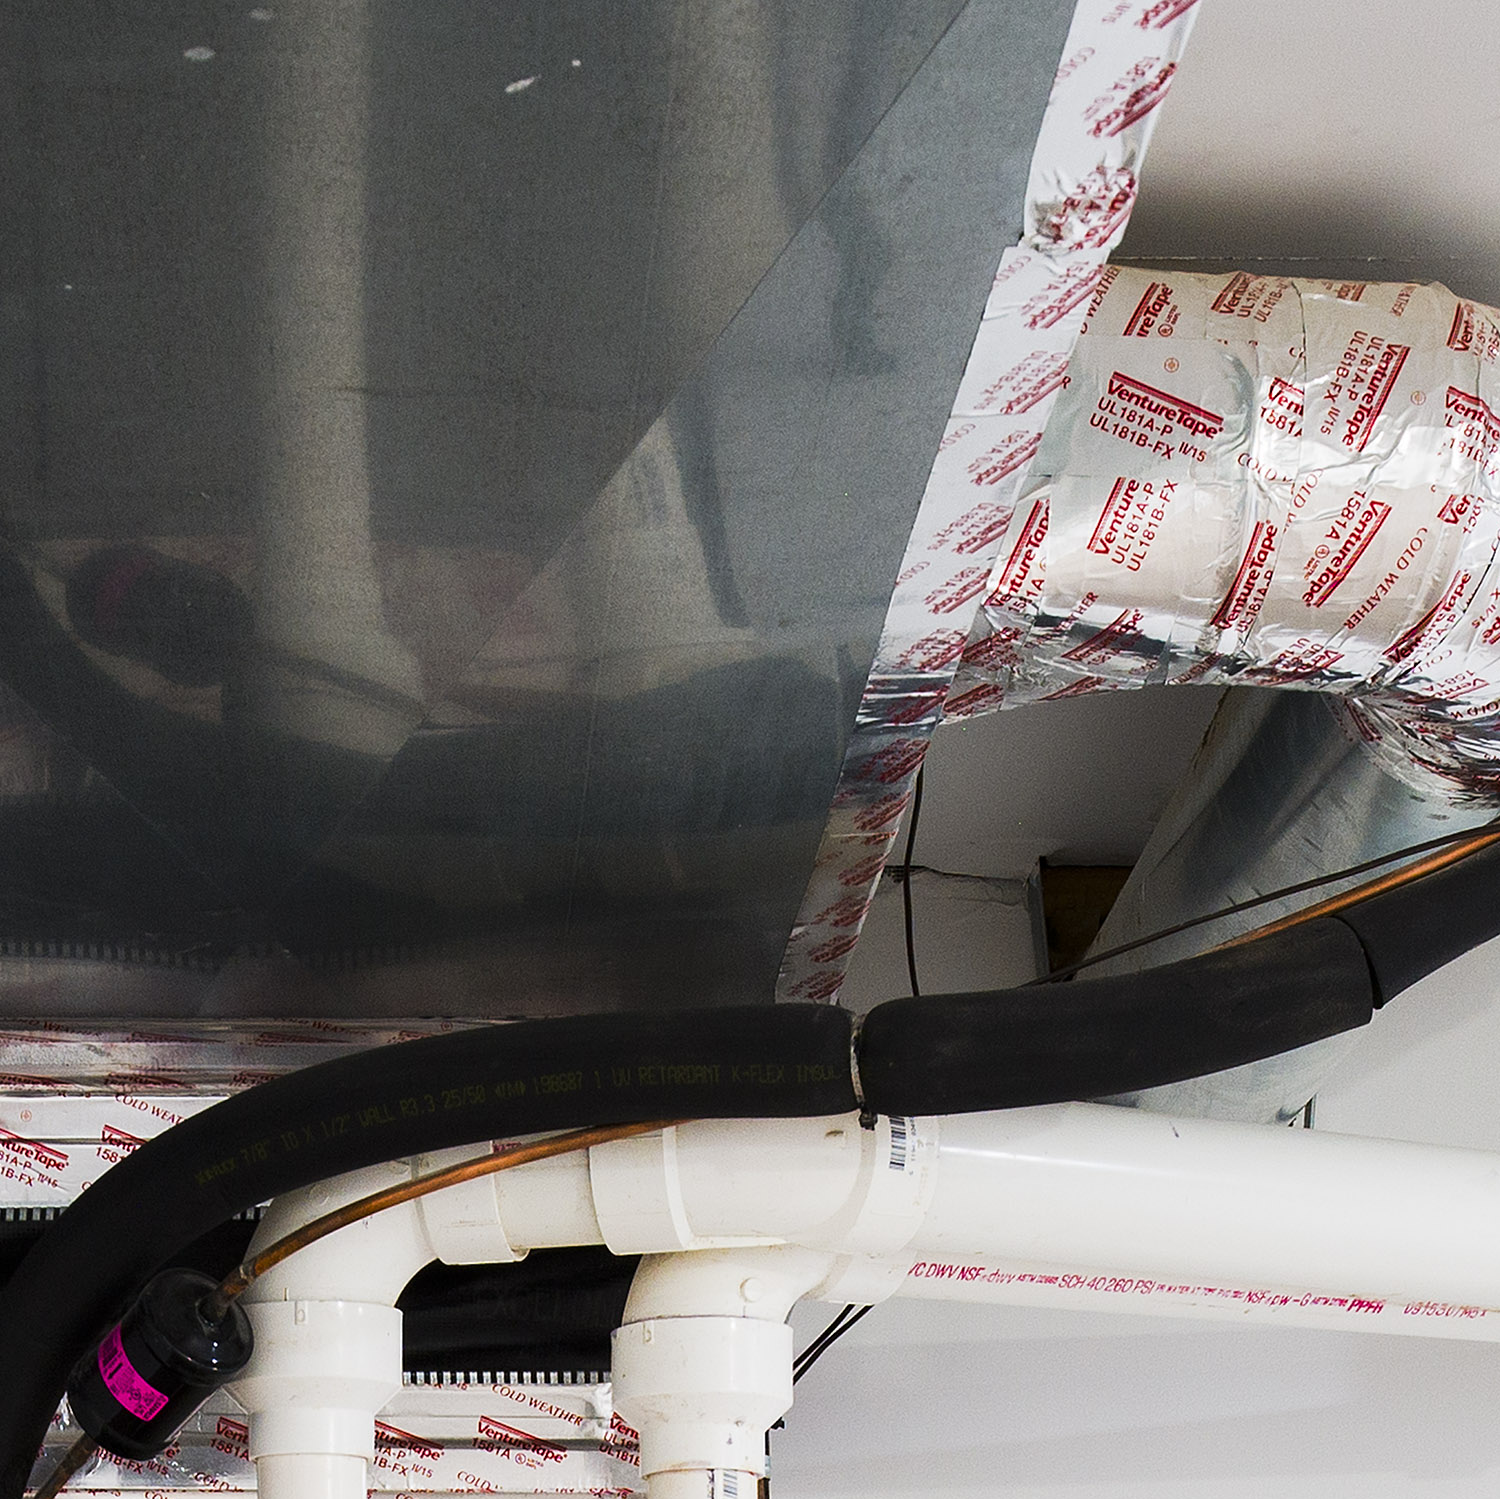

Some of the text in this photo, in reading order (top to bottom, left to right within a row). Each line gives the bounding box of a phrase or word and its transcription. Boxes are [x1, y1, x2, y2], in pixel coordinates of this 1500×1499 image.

[1107, 380, 1223, 438] VentureTape
[1342, 342, 1402, 448] VentureTape
[1090, 415, 1175, 459] UL181B-FX
[1095, 480, 1139, 556] Venture
[1112, 483, 1155, 564] UL181A-P
[1326, 489, 1367, 540] 1581A
[1344, 528, 1428, 630] COLD WEATHER
[925, 1263, 958, 1278] DWV
[1059, 1274, 1086, 1289] SCH
[1087, 1277, 1104, 1290] 40
[1104, 1278, 1133, 1292] 260
[1133, 1280, 1155, 1294] PSI
